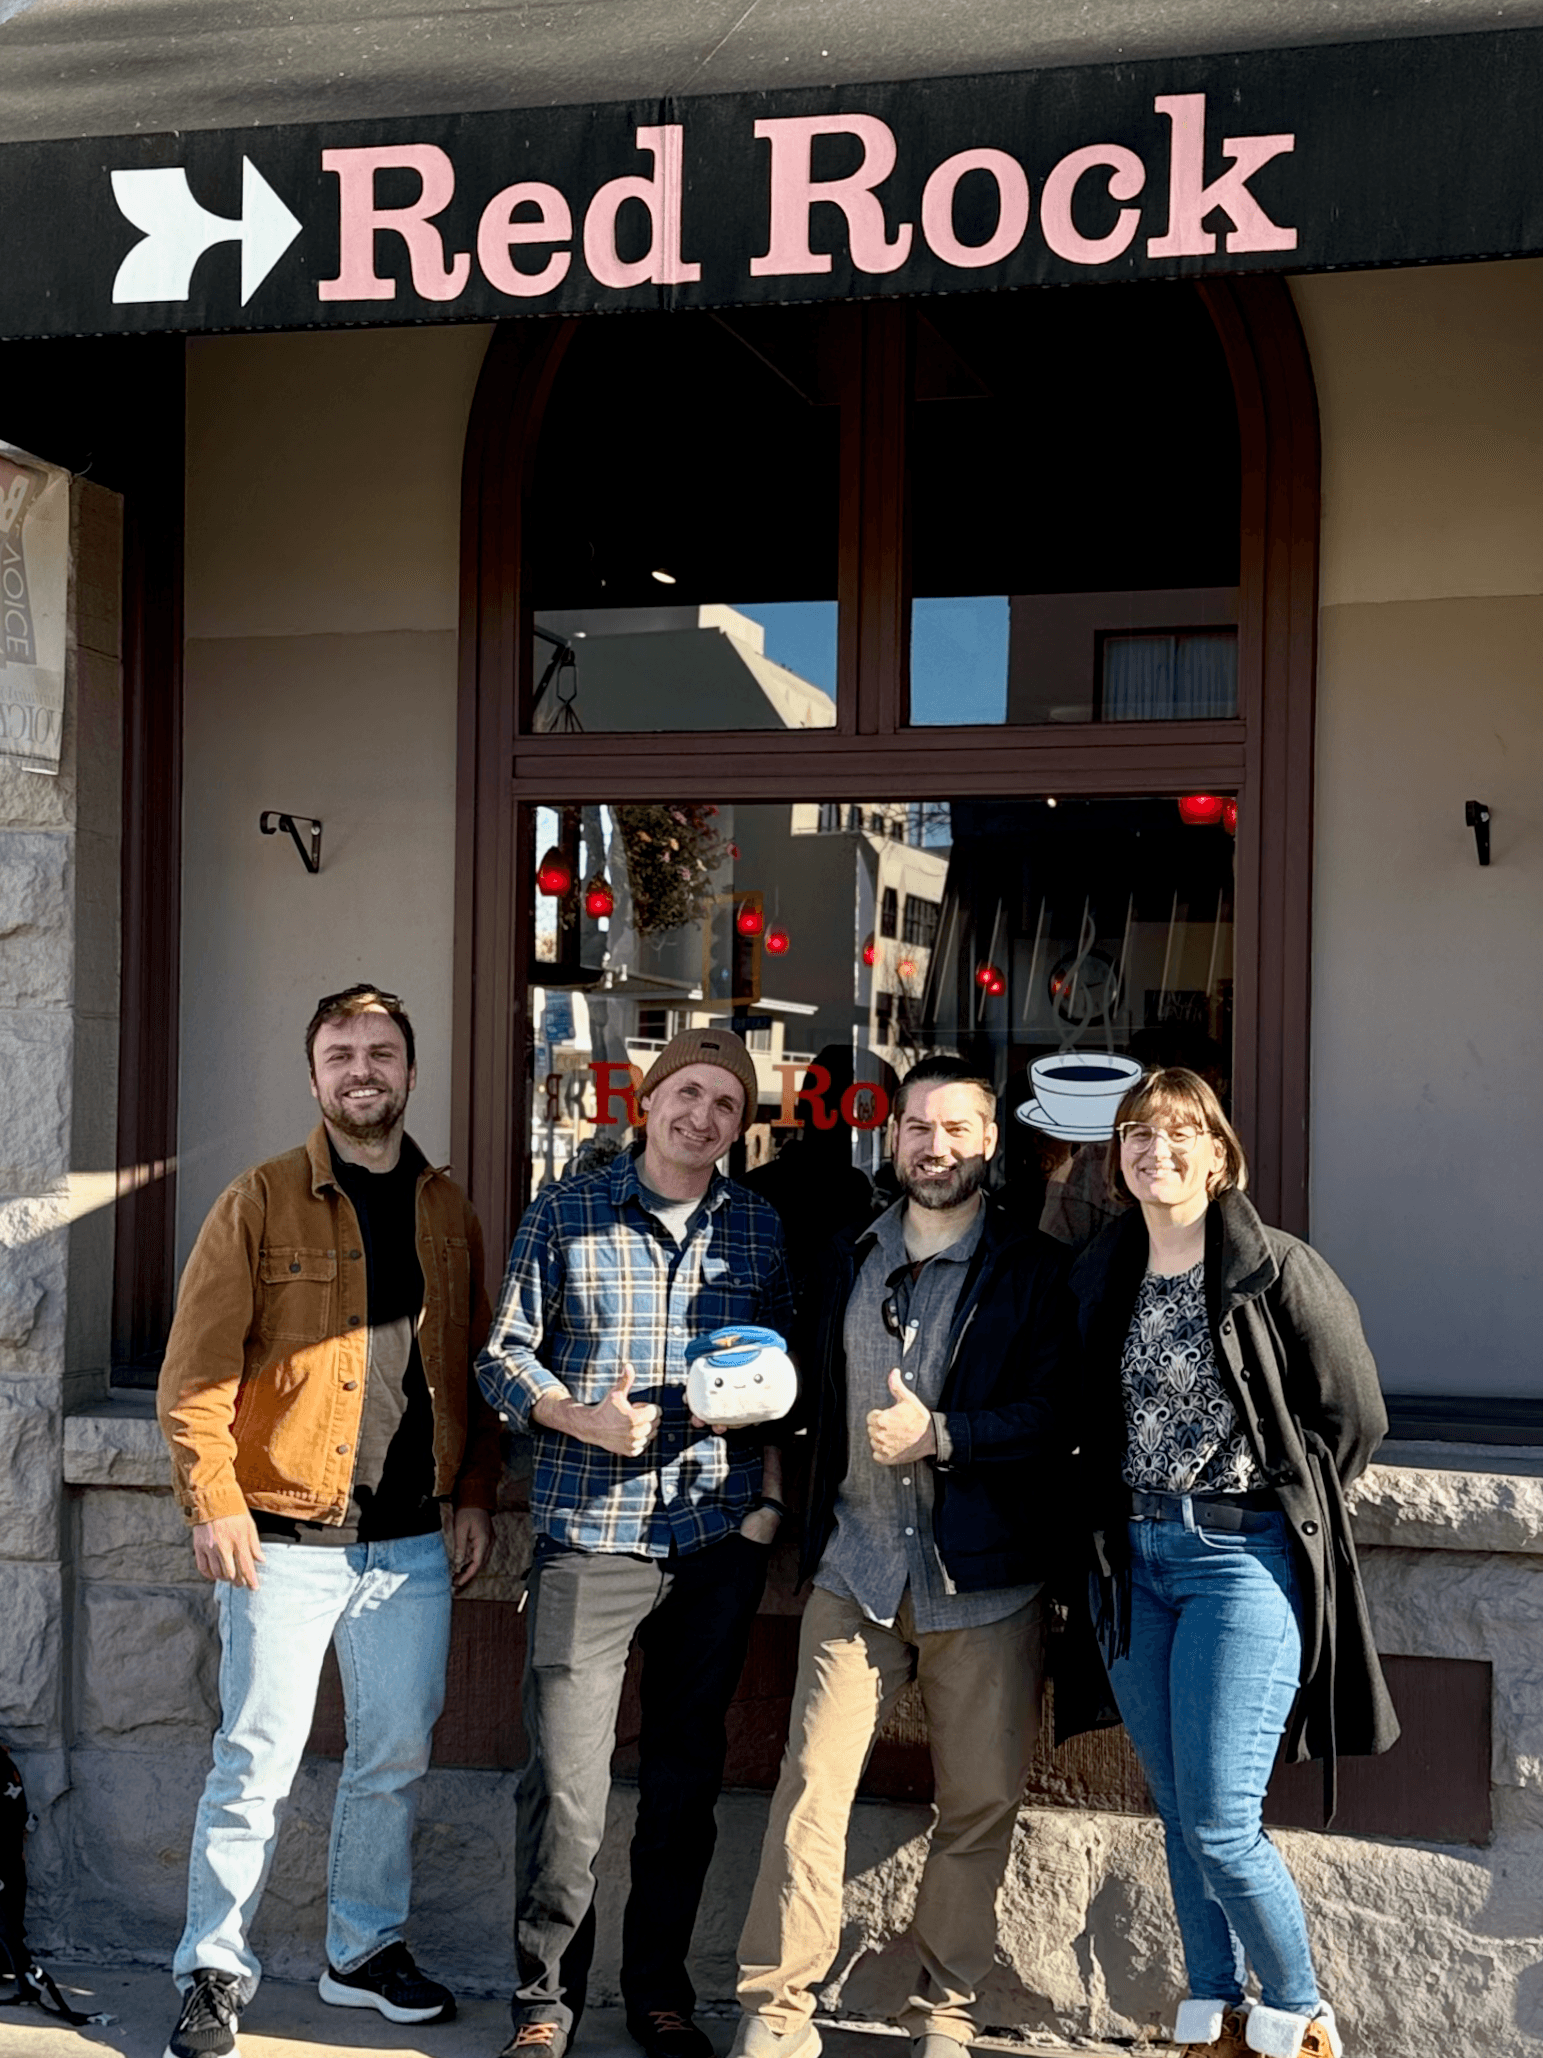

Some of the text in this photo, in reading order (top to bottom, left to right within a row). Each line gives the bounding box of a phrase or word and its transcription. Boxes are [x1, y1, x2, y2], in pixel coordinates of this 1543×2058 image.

[319, 94, 1296, 300] Red Rock
[770, 1063, 890, 1131] Ro
